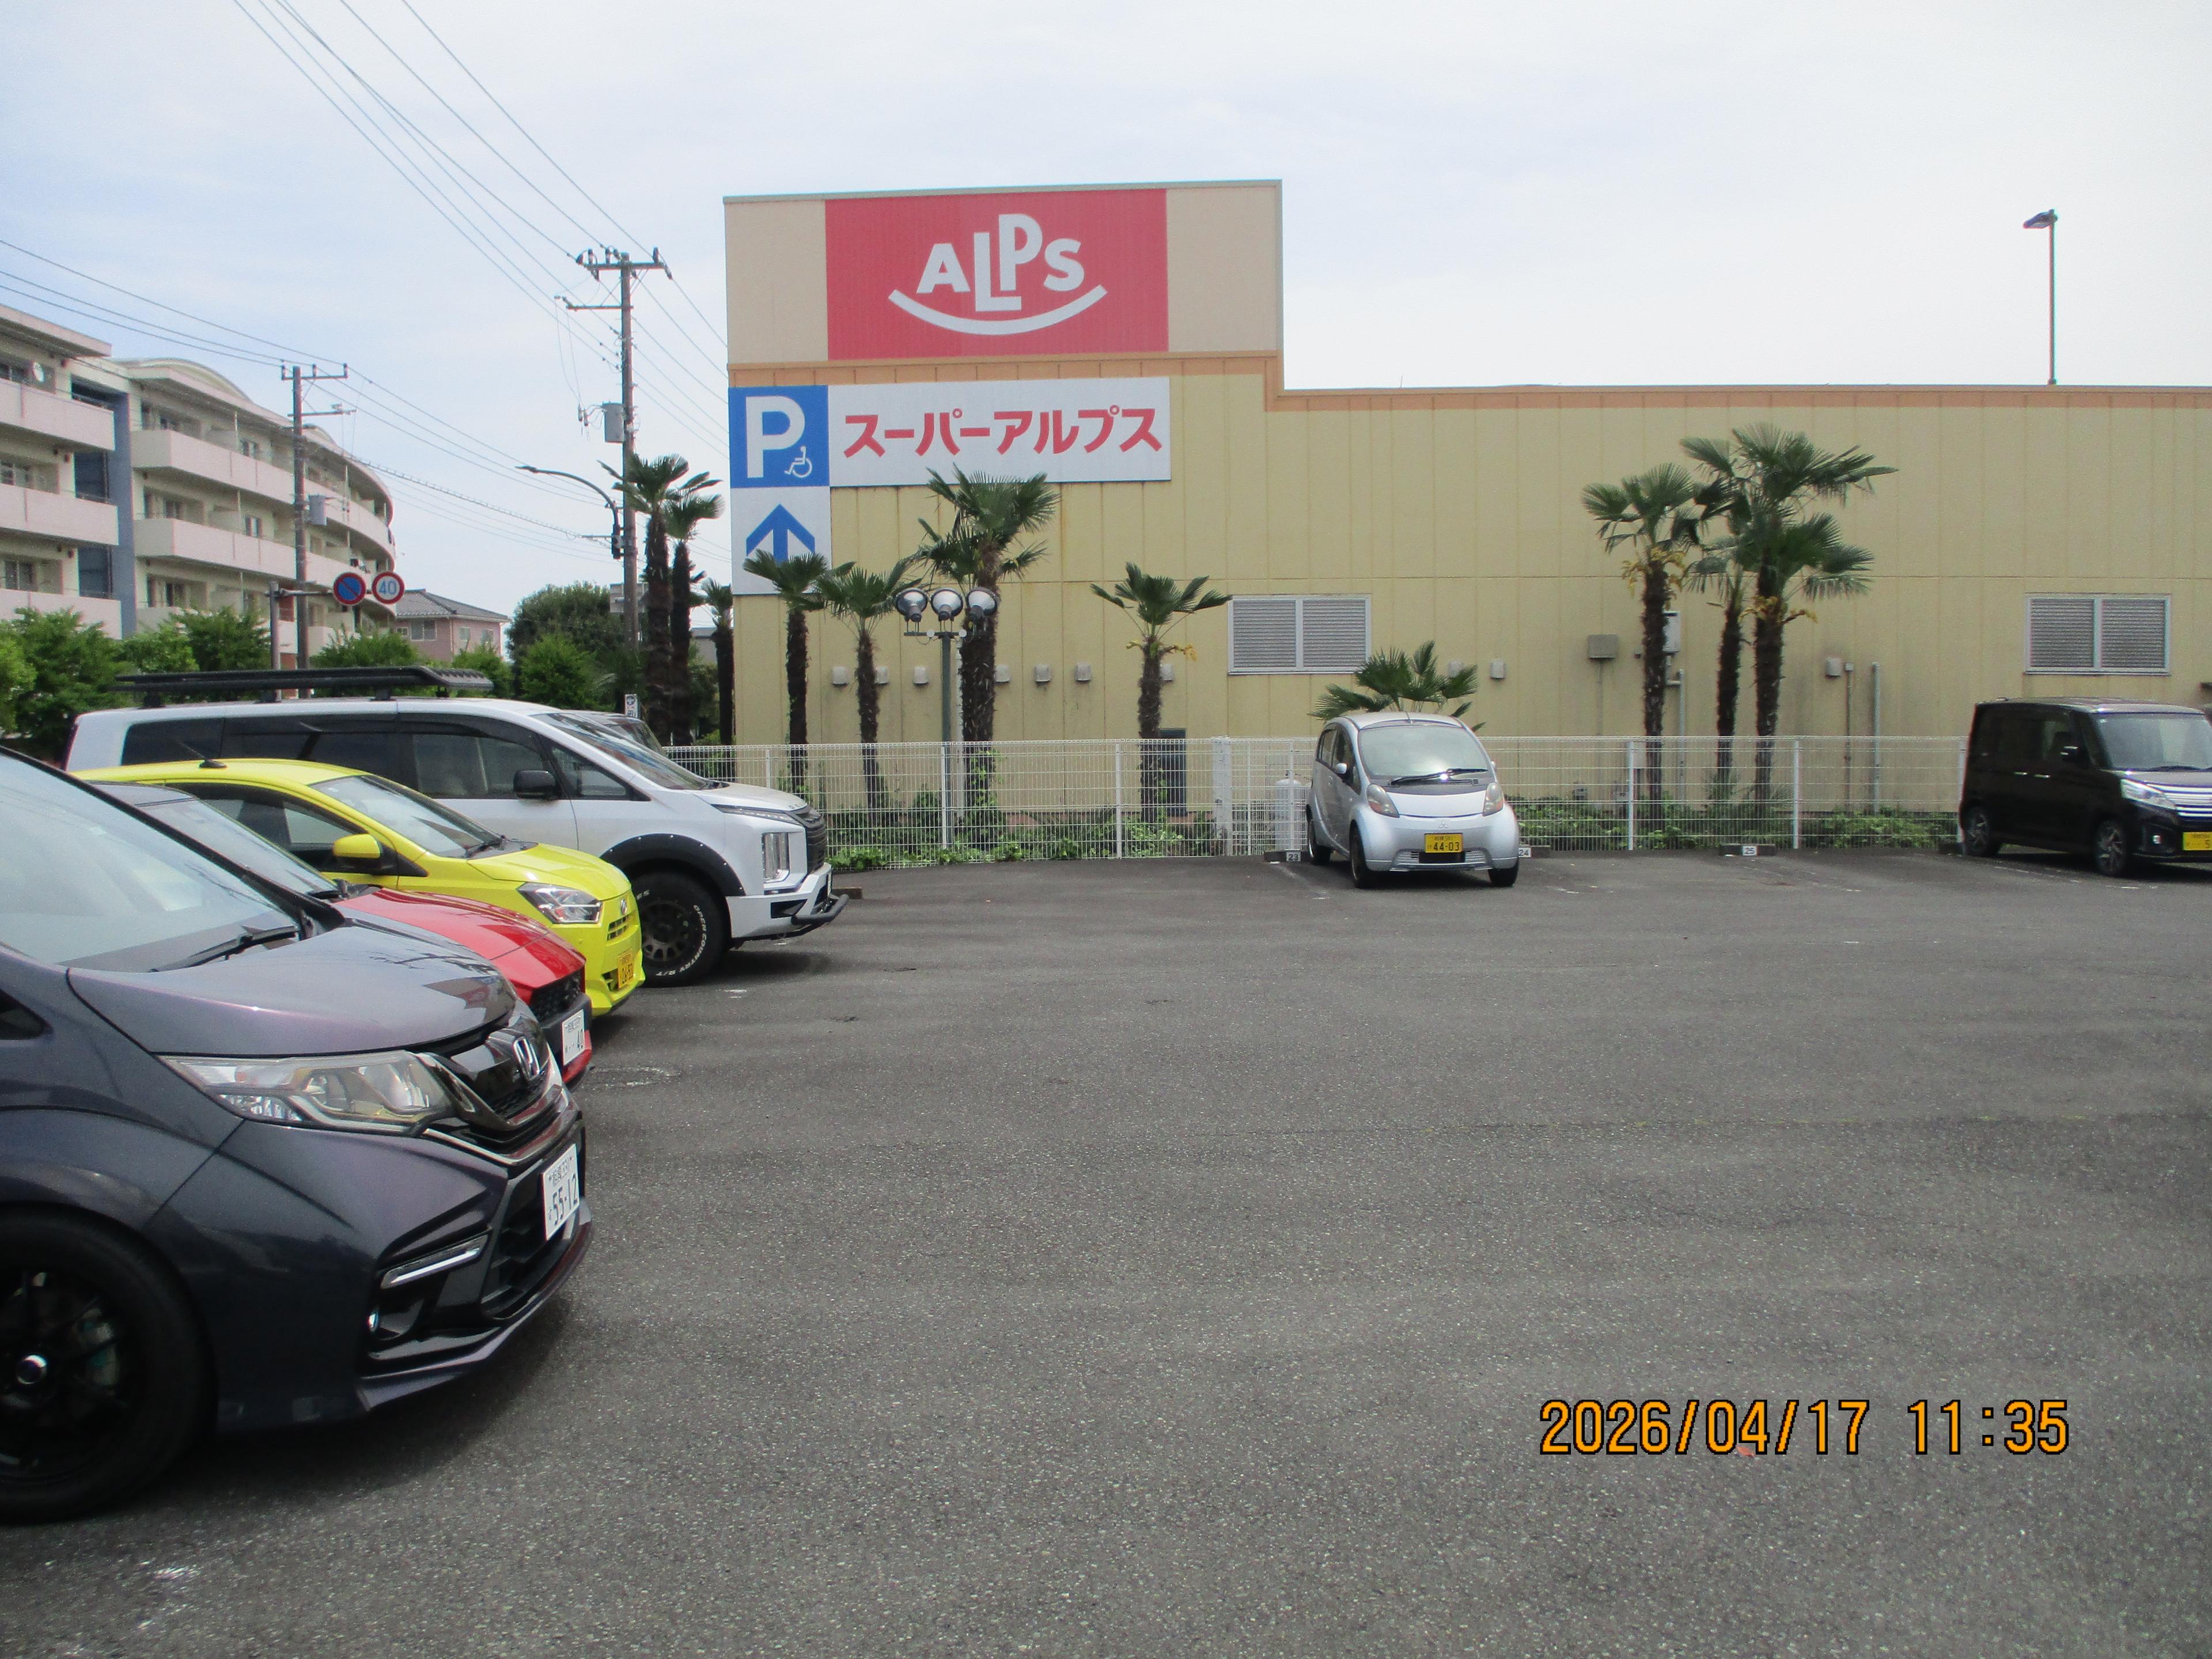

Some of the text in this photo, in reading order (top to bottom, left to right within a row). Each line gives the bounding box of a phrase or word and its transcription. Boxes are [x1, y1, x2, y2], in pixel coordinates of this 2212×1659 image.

[916, 213, 1085, 312] ALPS
[745, 395, 805, 479] P
[843, 405, 1162, 457] スーパーアルプス
[378, 580, 397, 595] 40
[1288, 853, 1299, 861] 23
[1433, 842, 1460, 851] 44-03
[693, 904, 707, 932] OPEN
[679, 933, 707, 973] COUNTRY
[552, 1172, 578, 1226] 55-12
